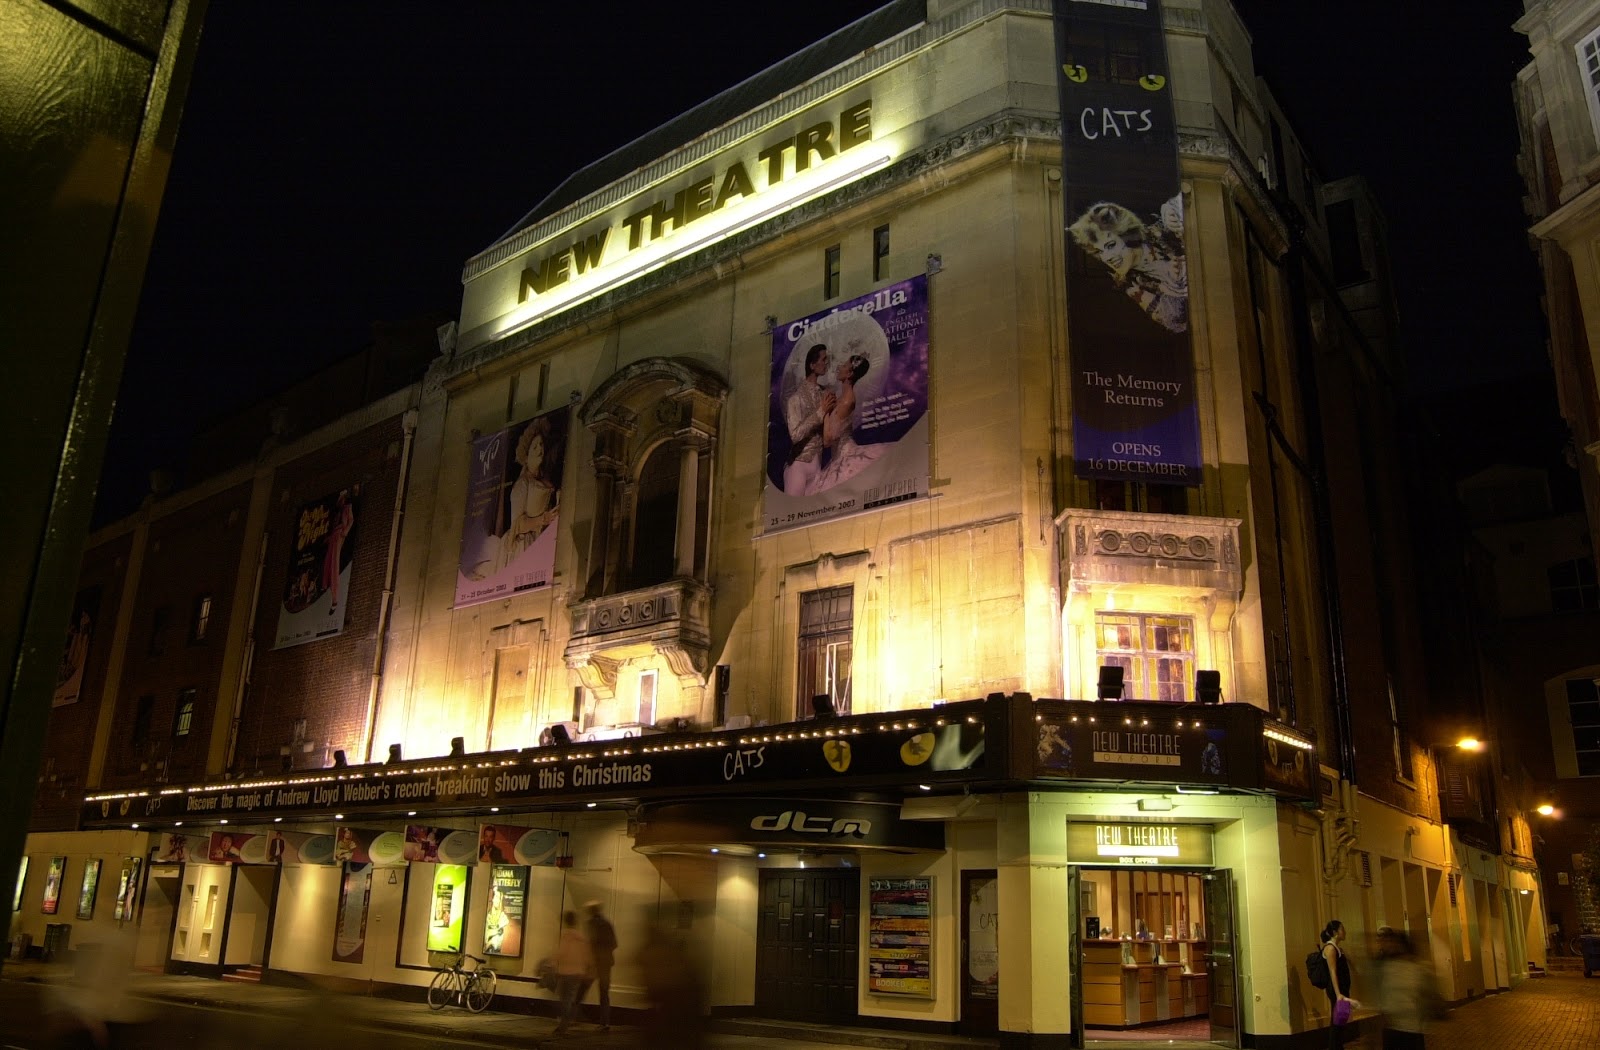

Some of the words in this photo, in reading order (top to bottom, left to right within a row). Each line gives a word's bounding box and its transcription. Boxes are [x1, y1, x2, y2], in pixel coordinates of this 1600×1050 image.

[1080, 108, 1152, 139] CATS
[517, 226, 612, 304] NEW
[622, 99, 872, 251] THEATRE
[787, 289, 907, 342] Cinderella
[1083, 372, 1114, 388] The
[1117, 373, 1182, 395] Memory
[1104, 389, 1164, 408] Returns
[1112, 441, 1162, 457] OPENS
[1088, 457, 1104, 471] 16
[1106, 459, 1187, 477] DECEMBER
[787, 512, 796, 522] 29
[797, 504, 836, 520] November
[838, 499, 856, 511] 2003
[1092, 730, 1121, 753] NEW
[1127, 732, 1181, 755] THEATRE
[723, 746, 764, 781] CATS
[1103, 753, 1172, 765] OXFORD
[187, 795, 218, 812] Discover
[221, 793, 235, 808] the
[236, 791, 261, 812] magic
[264, 789, 274, 807] of
[276, 788, 309, 806] Andrew
[313, 785, 339, 805] Lloyd
[343, 782, 390, 803] Webber's
[394, 775, 490, 799] record-breaking
[495, 772, 531, 793] show
[538, 767, 565, 789] this
[572, 762, 652, 787] Christmas
[1096, 825, 1122, 845] NEW
[1127, 826, 1178, 846] THEATRE
